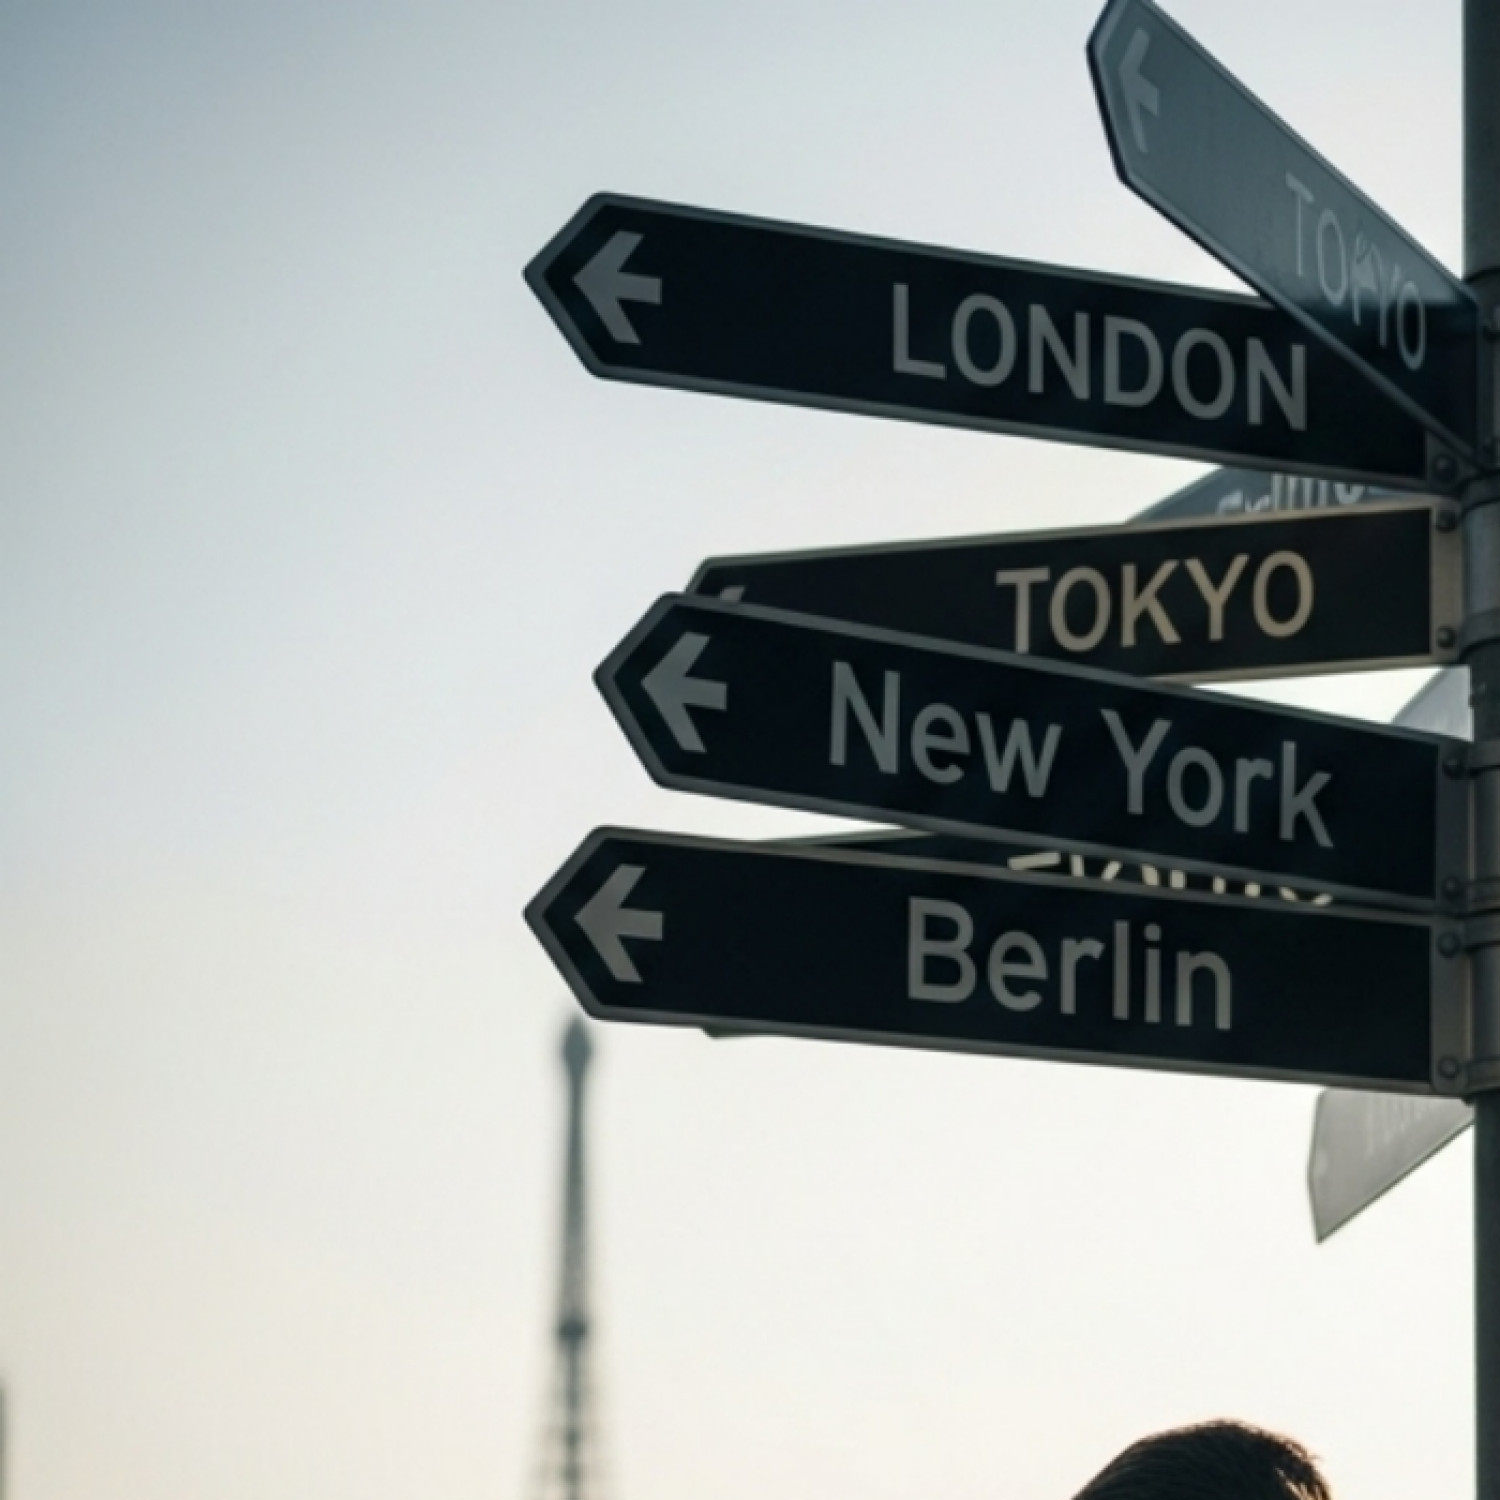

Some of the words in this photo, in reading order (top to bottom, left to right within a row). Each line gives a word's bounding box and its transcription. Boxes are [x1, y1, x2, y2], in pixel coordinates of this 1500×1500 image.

[892, 284, 1307, 430] LONDON
[996, 551, 1314, 654] TOKYO
[829, 661, 1062, 797] New
[1101, 709, 1335, 847] York
[908, 898, 1233, 1030] Berlin
